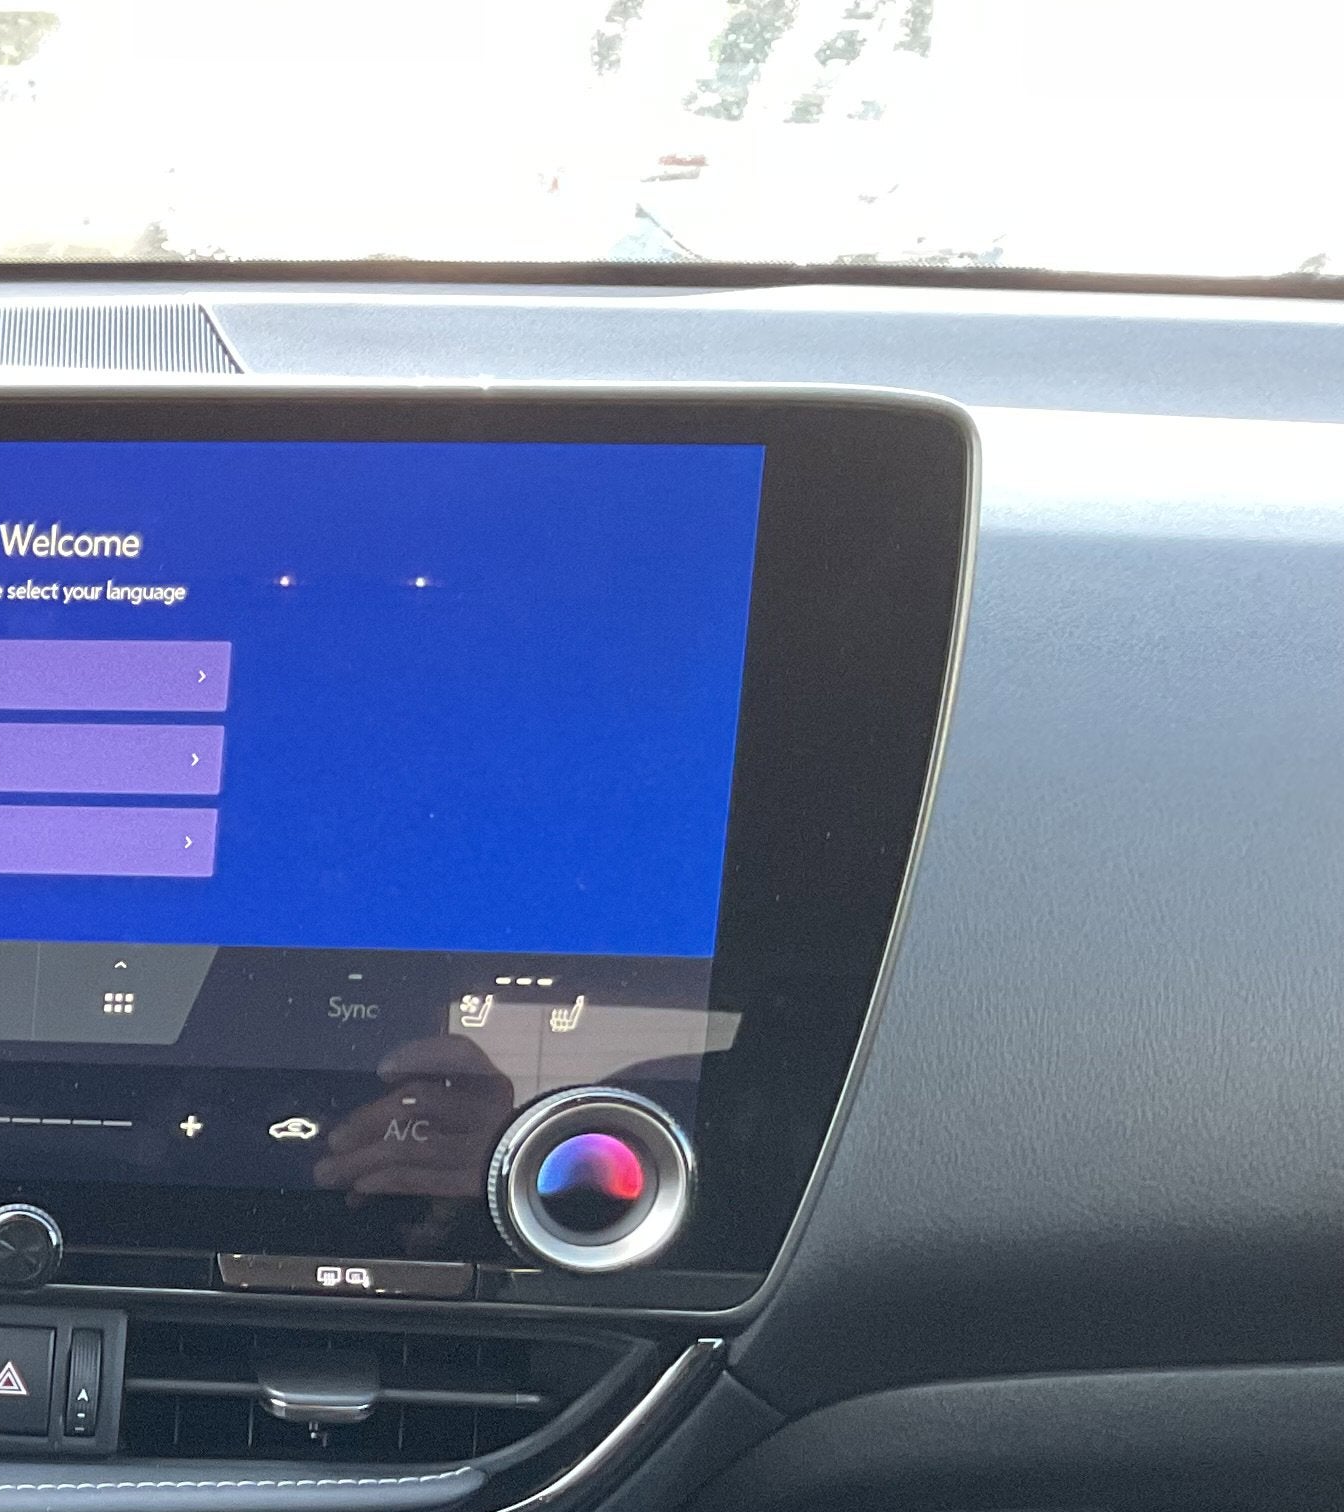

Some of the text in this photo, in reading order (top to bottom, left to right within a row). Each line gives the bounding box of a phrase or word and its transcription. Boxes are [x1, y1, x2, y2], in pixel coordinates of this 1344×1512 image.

[0, 523, 140, 557] Welcome
[6, 579, 59, 600] select
[62, 585, 102, 605] your
[106, 579, 187, 606] language
[327, 996, 379, 1021] Sync
[383, 1118, 429, 1143] A/C
